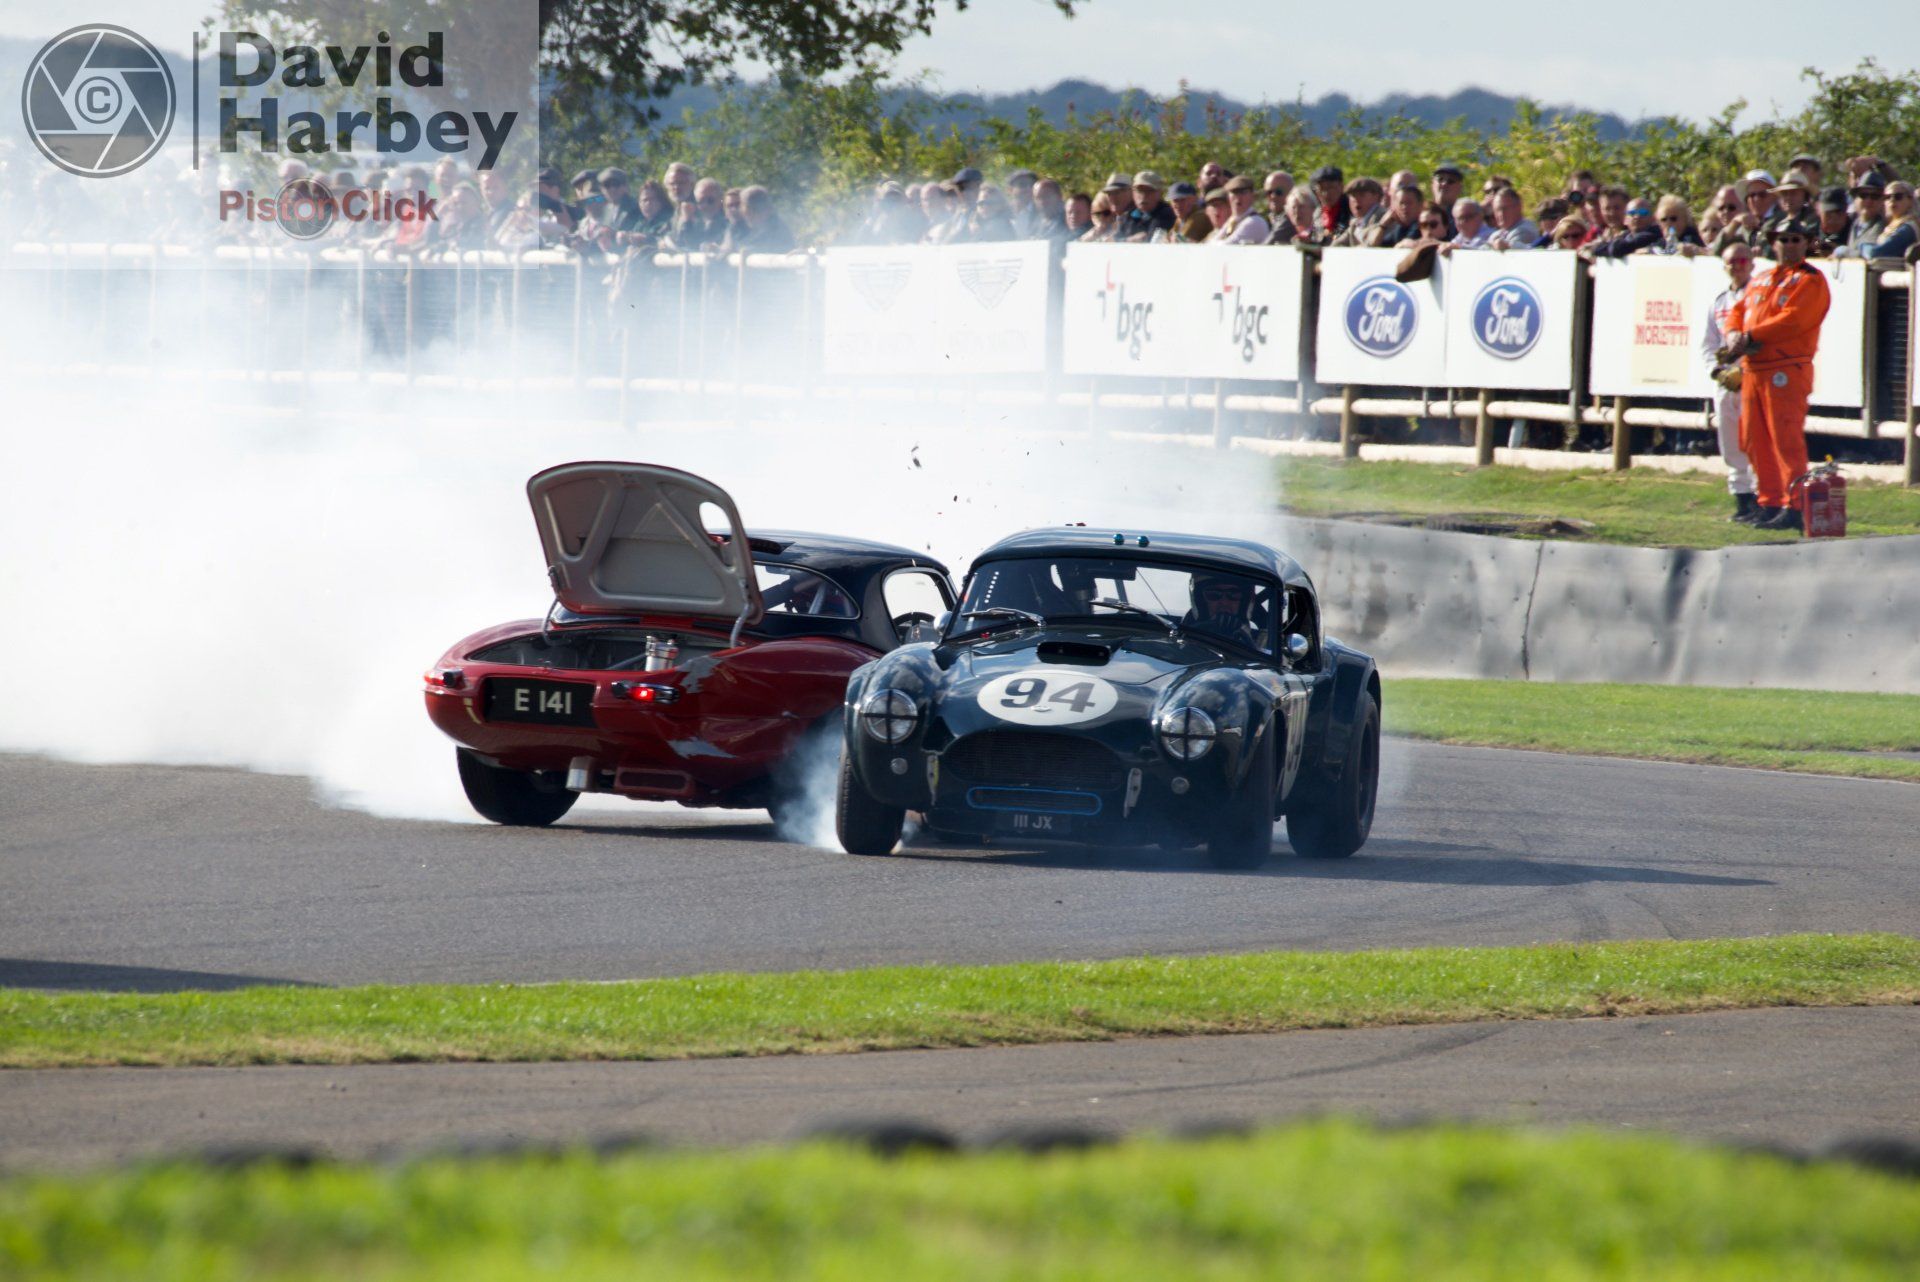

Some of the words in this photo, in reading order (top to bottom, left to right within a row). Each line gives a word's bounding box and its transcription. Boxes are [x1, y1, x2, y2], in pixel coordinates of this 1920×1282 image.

[1117, 283, 1154, 360] bgc
[1233, 286, 1269, 363] bgc
[1359, 286, 1407, 344] Ford
[1485, 288, 1531, 345] Ford
[1644, 300, 1683, 322] BIRRA
[1635, 324, 1690, 346] MORETTI
[514, 688, 530, 712] E
[539, 690, 573, 715] 141
[1000, 677, 1097, 714] 94
[1032, 815, 1053, 830] JX
